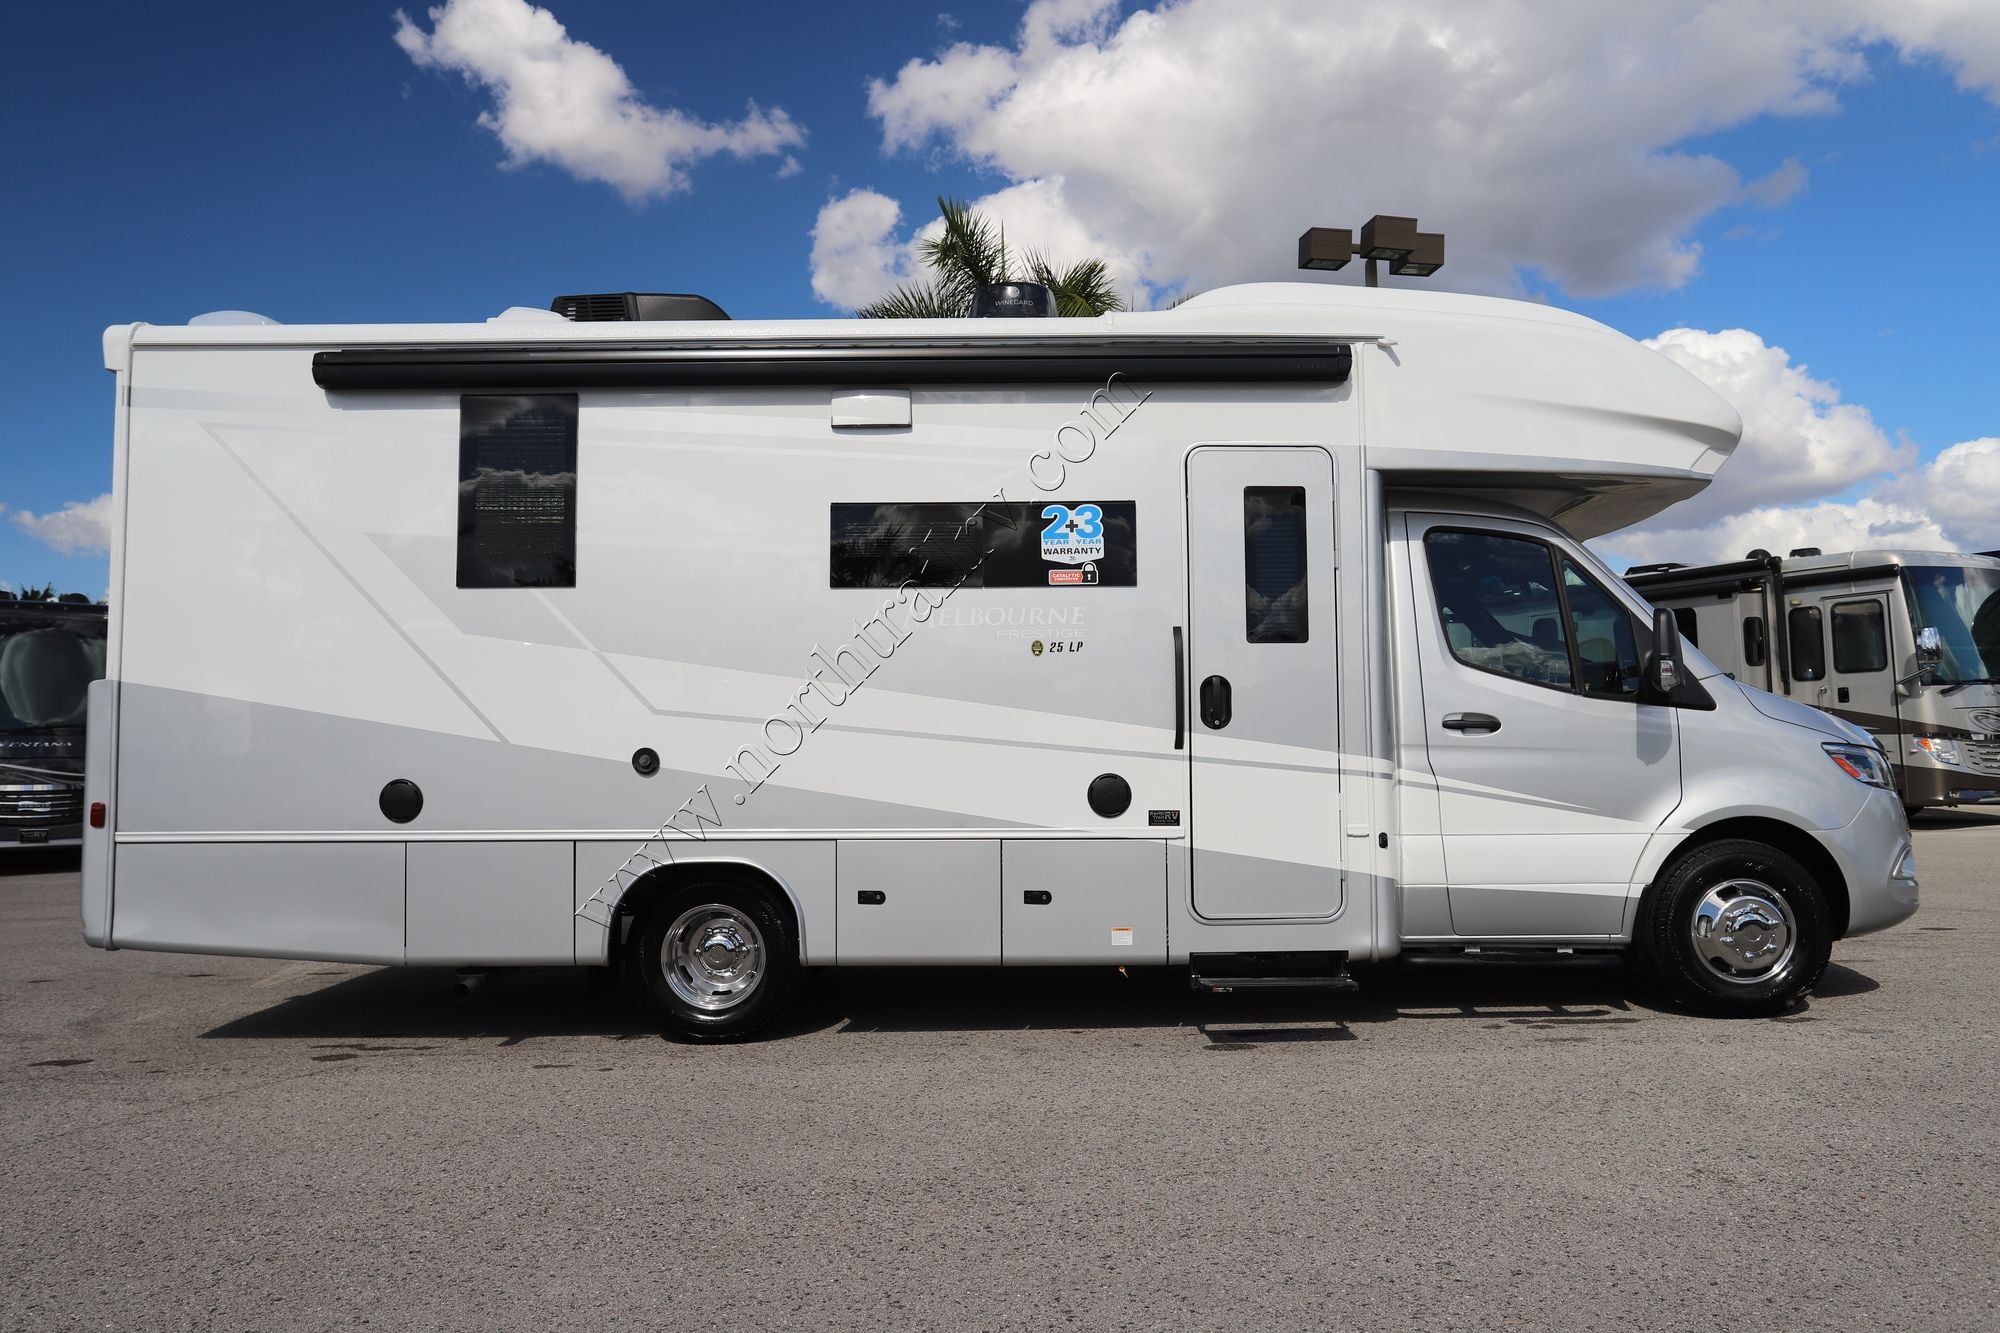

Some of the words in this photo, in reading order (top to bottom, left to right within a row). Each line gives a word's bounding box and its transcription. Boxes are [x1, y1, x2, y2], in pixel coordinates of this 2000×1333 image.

[1043, 547, 1102, 555] WARRANTY
[903, 606, 1086, 629] MELBOURNE
[996, 629, 1085, 639] PRESTIGE
[1049, 641, 1064, 653] 25
[1069, 641, 1084, 652] LP
